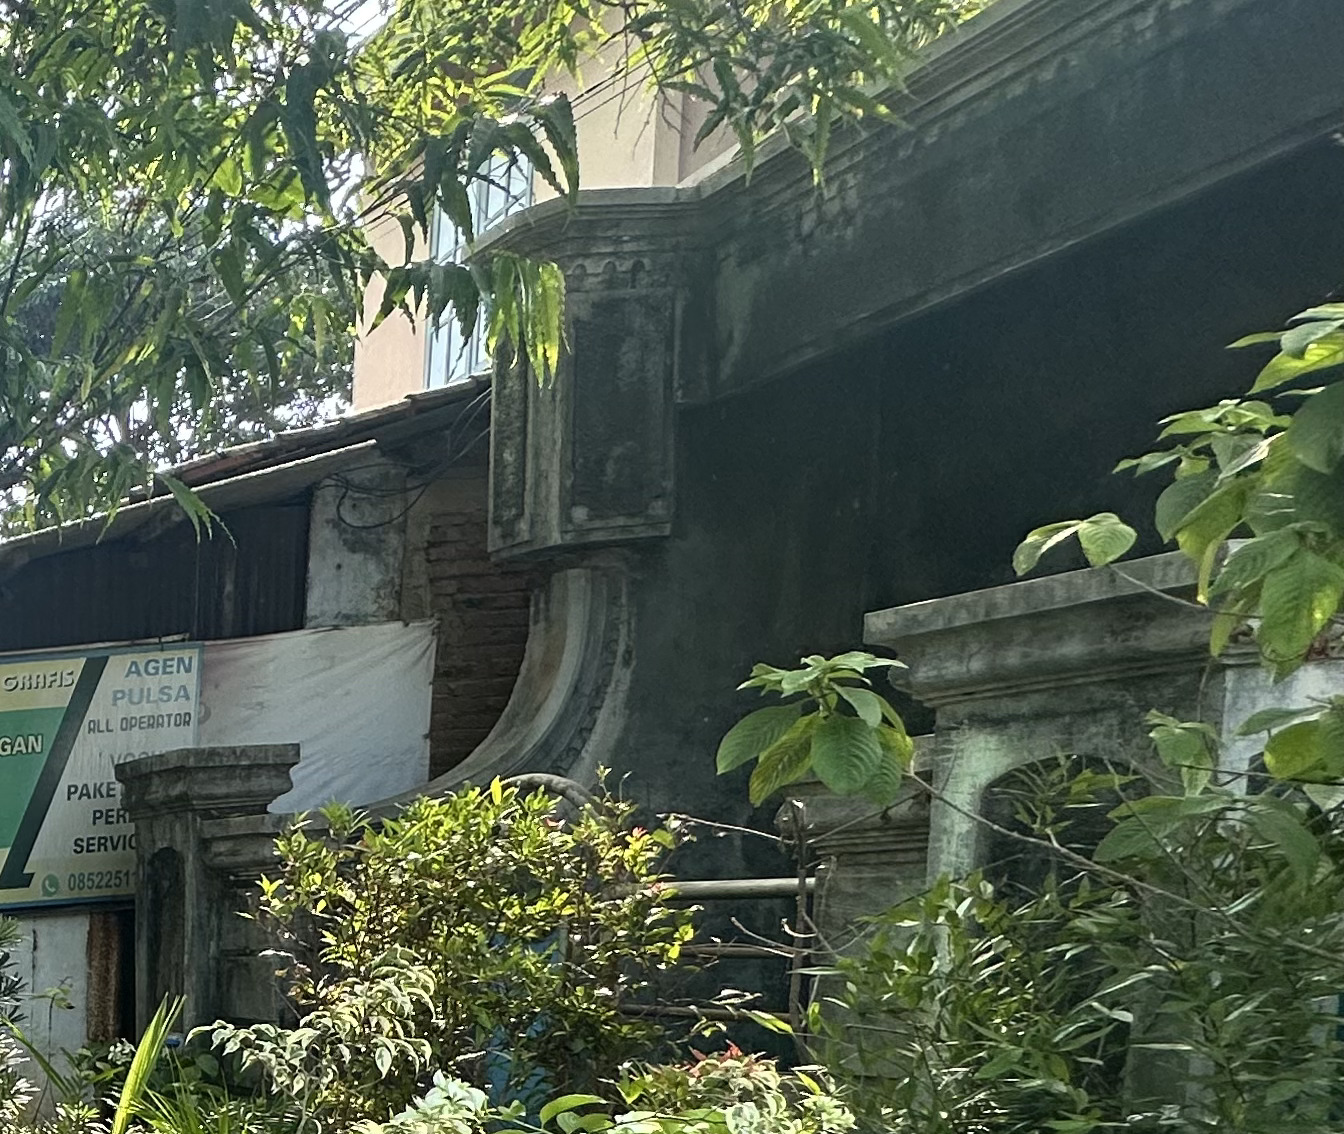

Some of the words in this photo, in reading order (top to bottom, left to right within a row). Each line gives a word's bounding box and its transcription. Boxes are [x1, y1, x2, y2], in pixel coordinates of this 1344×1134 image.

[124, 656, 193, 679] AGEN
[2, 670, 75, 692] GRAFIS
[112, 684, 191, 707] PULSA
[87, 717, 114, 735] ALL
[120, 711, 192, 732] OPERATOR
[66, 781, 117, 801] PAKE
[67, 869, 136, 892] 0852251
